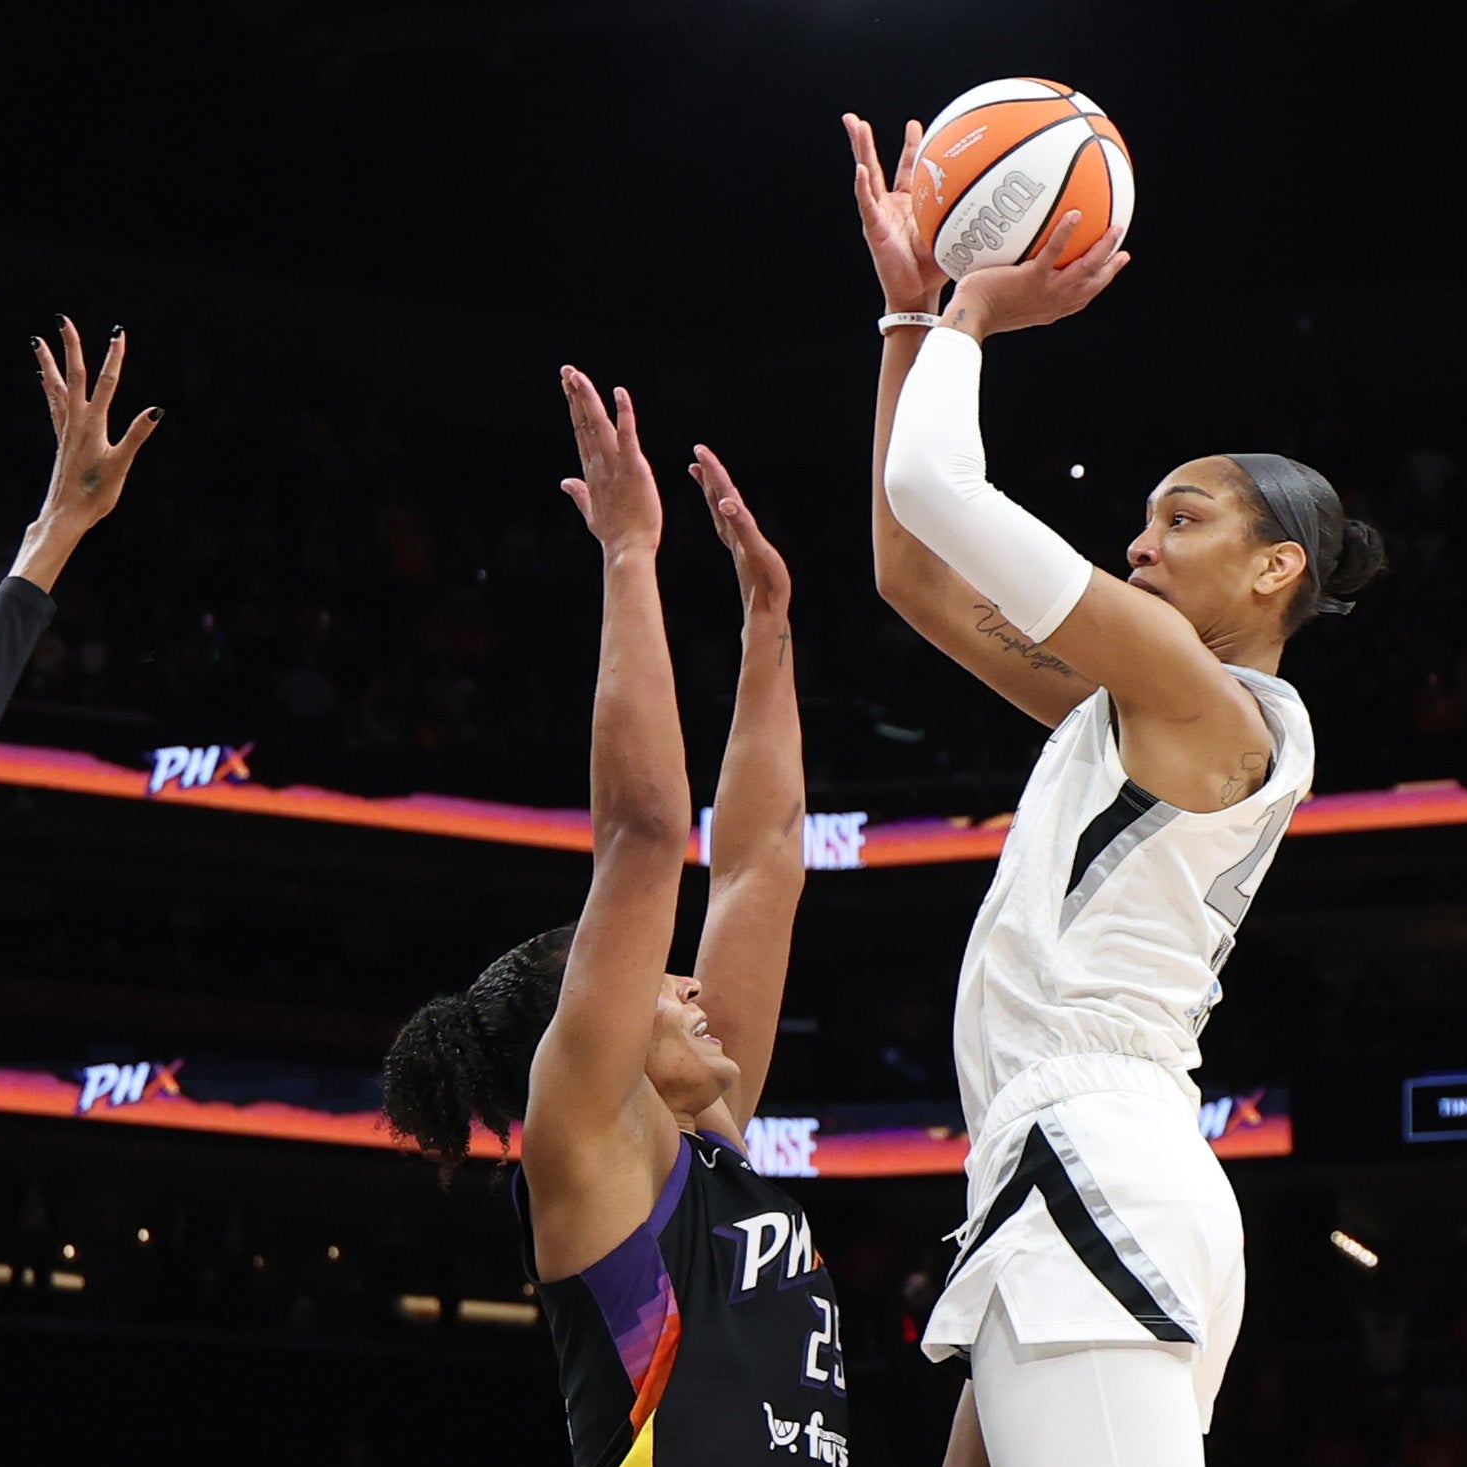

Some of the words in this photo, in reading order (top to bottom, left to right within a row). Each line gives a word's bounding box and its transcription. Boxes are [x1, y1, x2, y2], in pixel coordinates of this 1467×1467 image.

[941, 170, 1046, 276] Wilson
[147, 741, 255, 795] PHX
[77, 1059, 185, 1113] PHX
